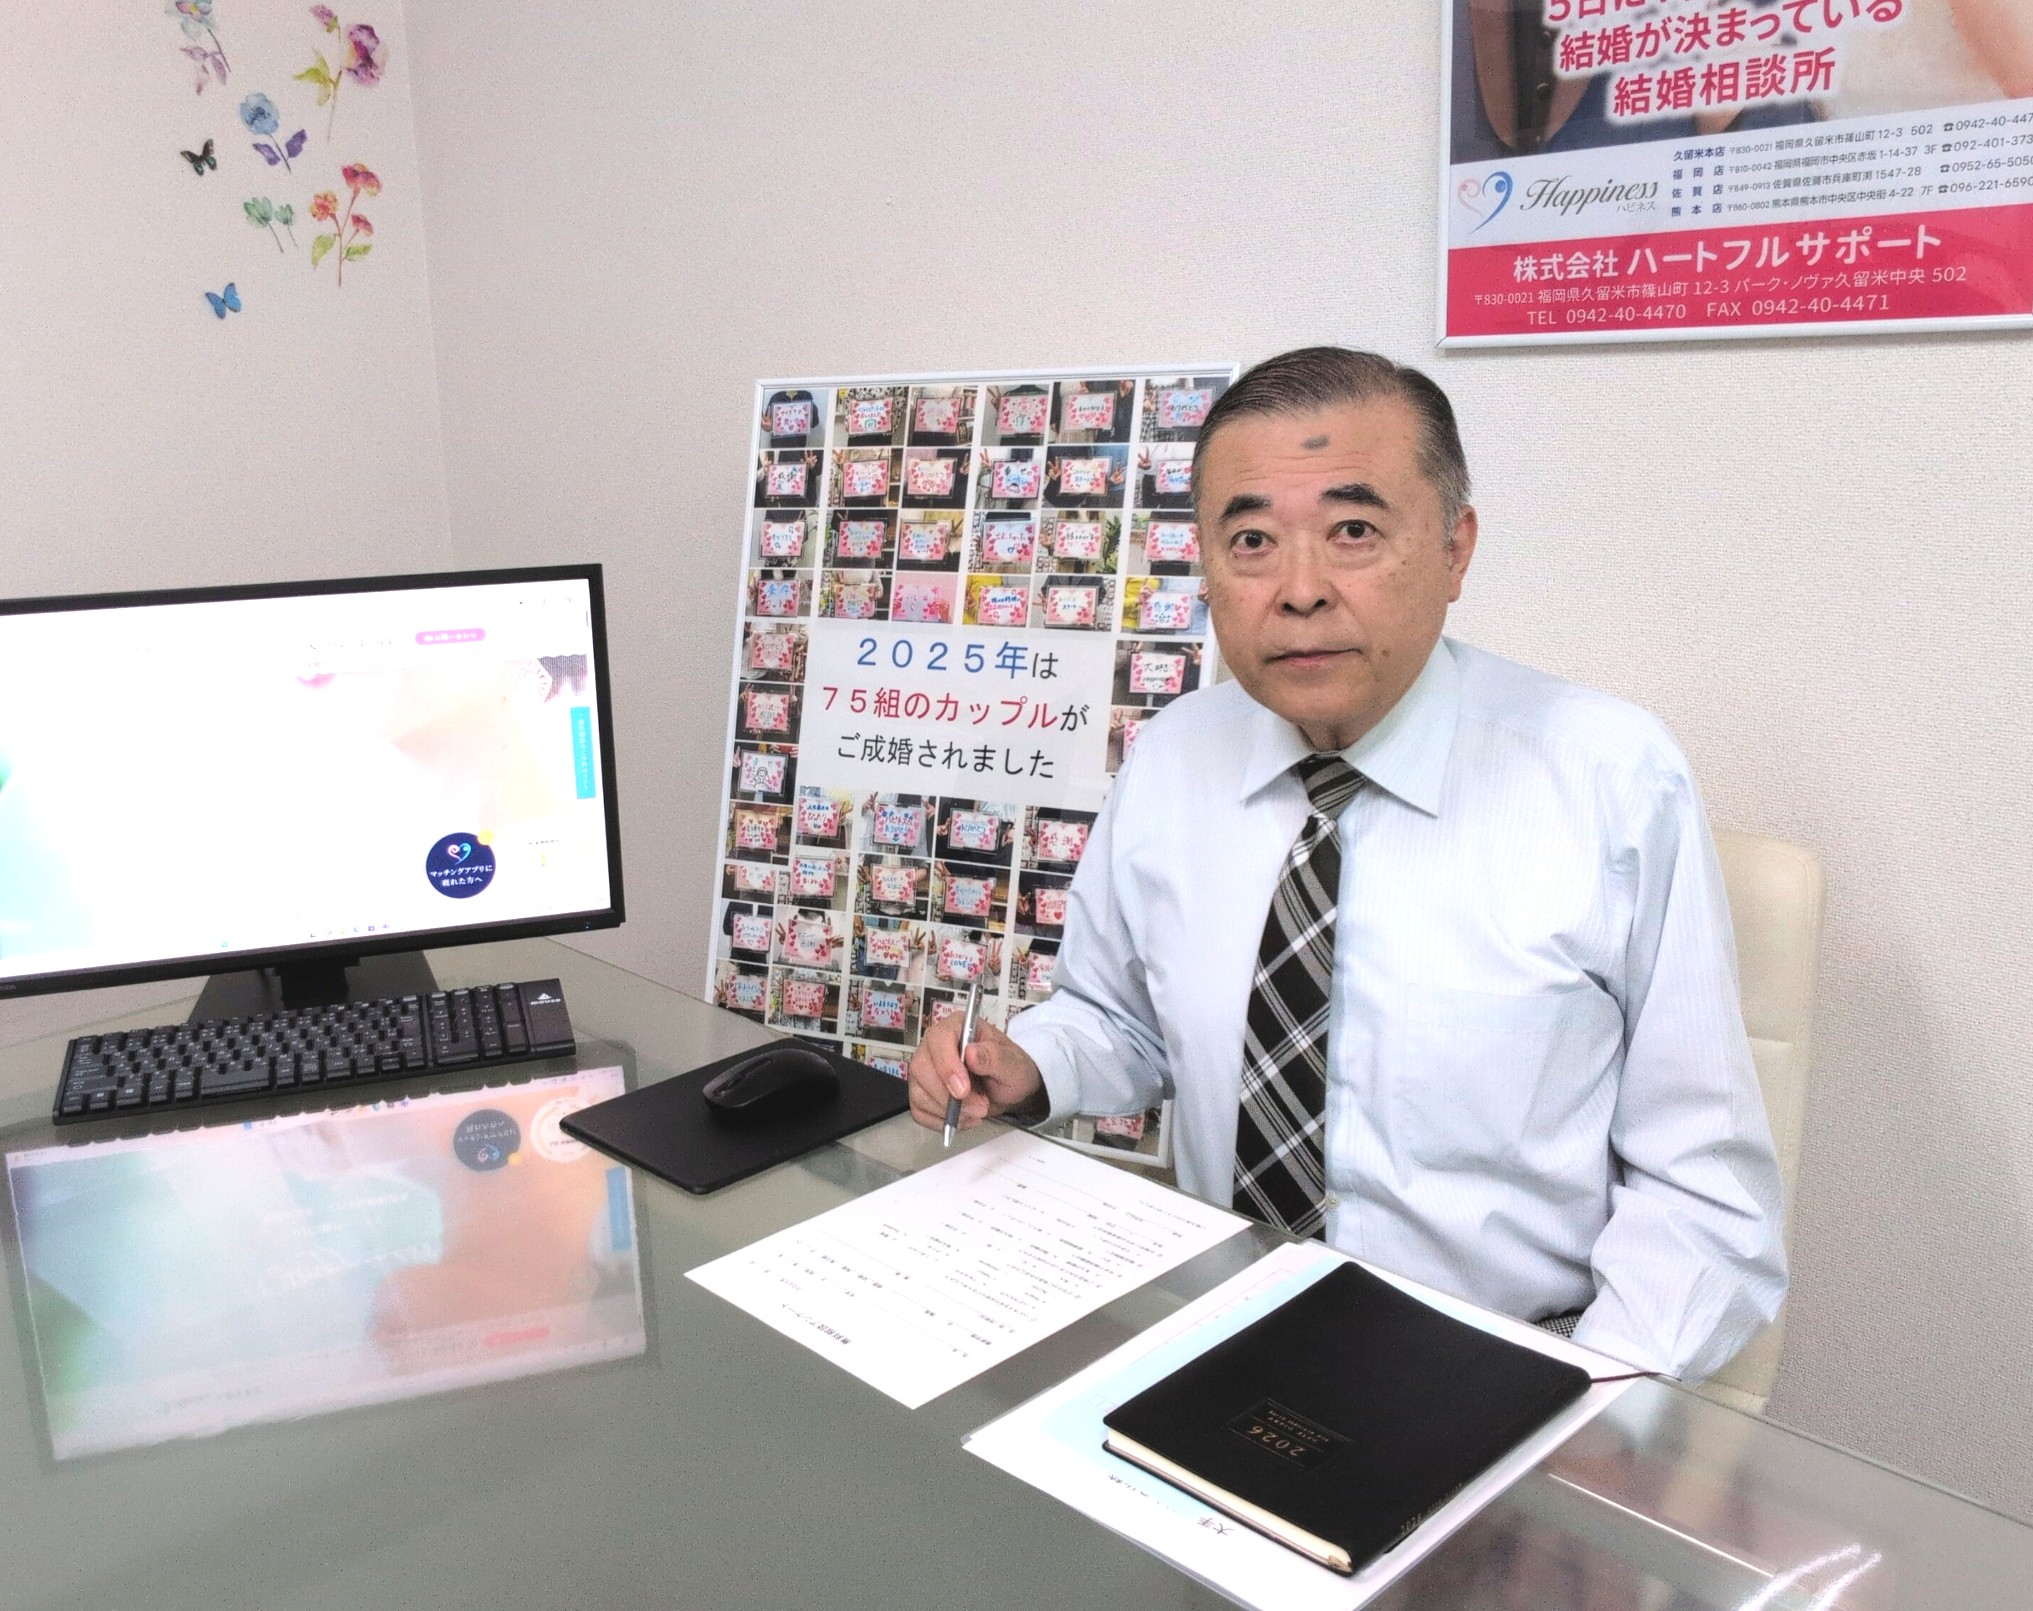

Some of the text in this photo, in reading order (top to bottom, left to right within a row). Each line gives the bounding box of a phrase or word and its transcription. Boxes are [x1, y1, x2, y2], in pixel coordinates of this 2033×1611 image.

[1560, 0, 1902, 71] 結婚が決まっている
[1613, 46, 1836, 117] 結婚相談所
[1673, 146, 1725, 161] 久留米本店
[1878, 128, 1903, 140] 12-3
[1911, 124, 1933, 136] 502
[1880, 146, 1918, 159] 1-14-37
[1924, 144, 1937, 155] 3F
[1876, 166, 1922, 180] 1547-28
[1520, 175, 1659, 216] Happiness
[1616, 201, 1656, 213] ハピネス
[1889, 187, 1914, 198] 4-22
[1921, 186, 1934, 196] 7F
[1513, 224, 1941, 283] 株式会社 ハートフルサポート
[1538, 281, 1689, 304] 福岡県久留米市篠山町
[1693, 280, 1729, 296] 12-3
[1734, 270, 1925, 294] パーク・ノヴァ久留米中央
[1932, 266, 1967, 283] 502
[1527, 294, 1889, 326] TEL 0942-40-4470 FAX 0942-40-4471
[857, 637, 1059, 680] 2025年は
[822, 686, 1090, 732] 75組のカップルが
[837, 733, 1054, 779] ご成婚されました
[430, 864, 493, 878] マッチングアプリに
[1244, 1423, 1307, 1457] 2026
